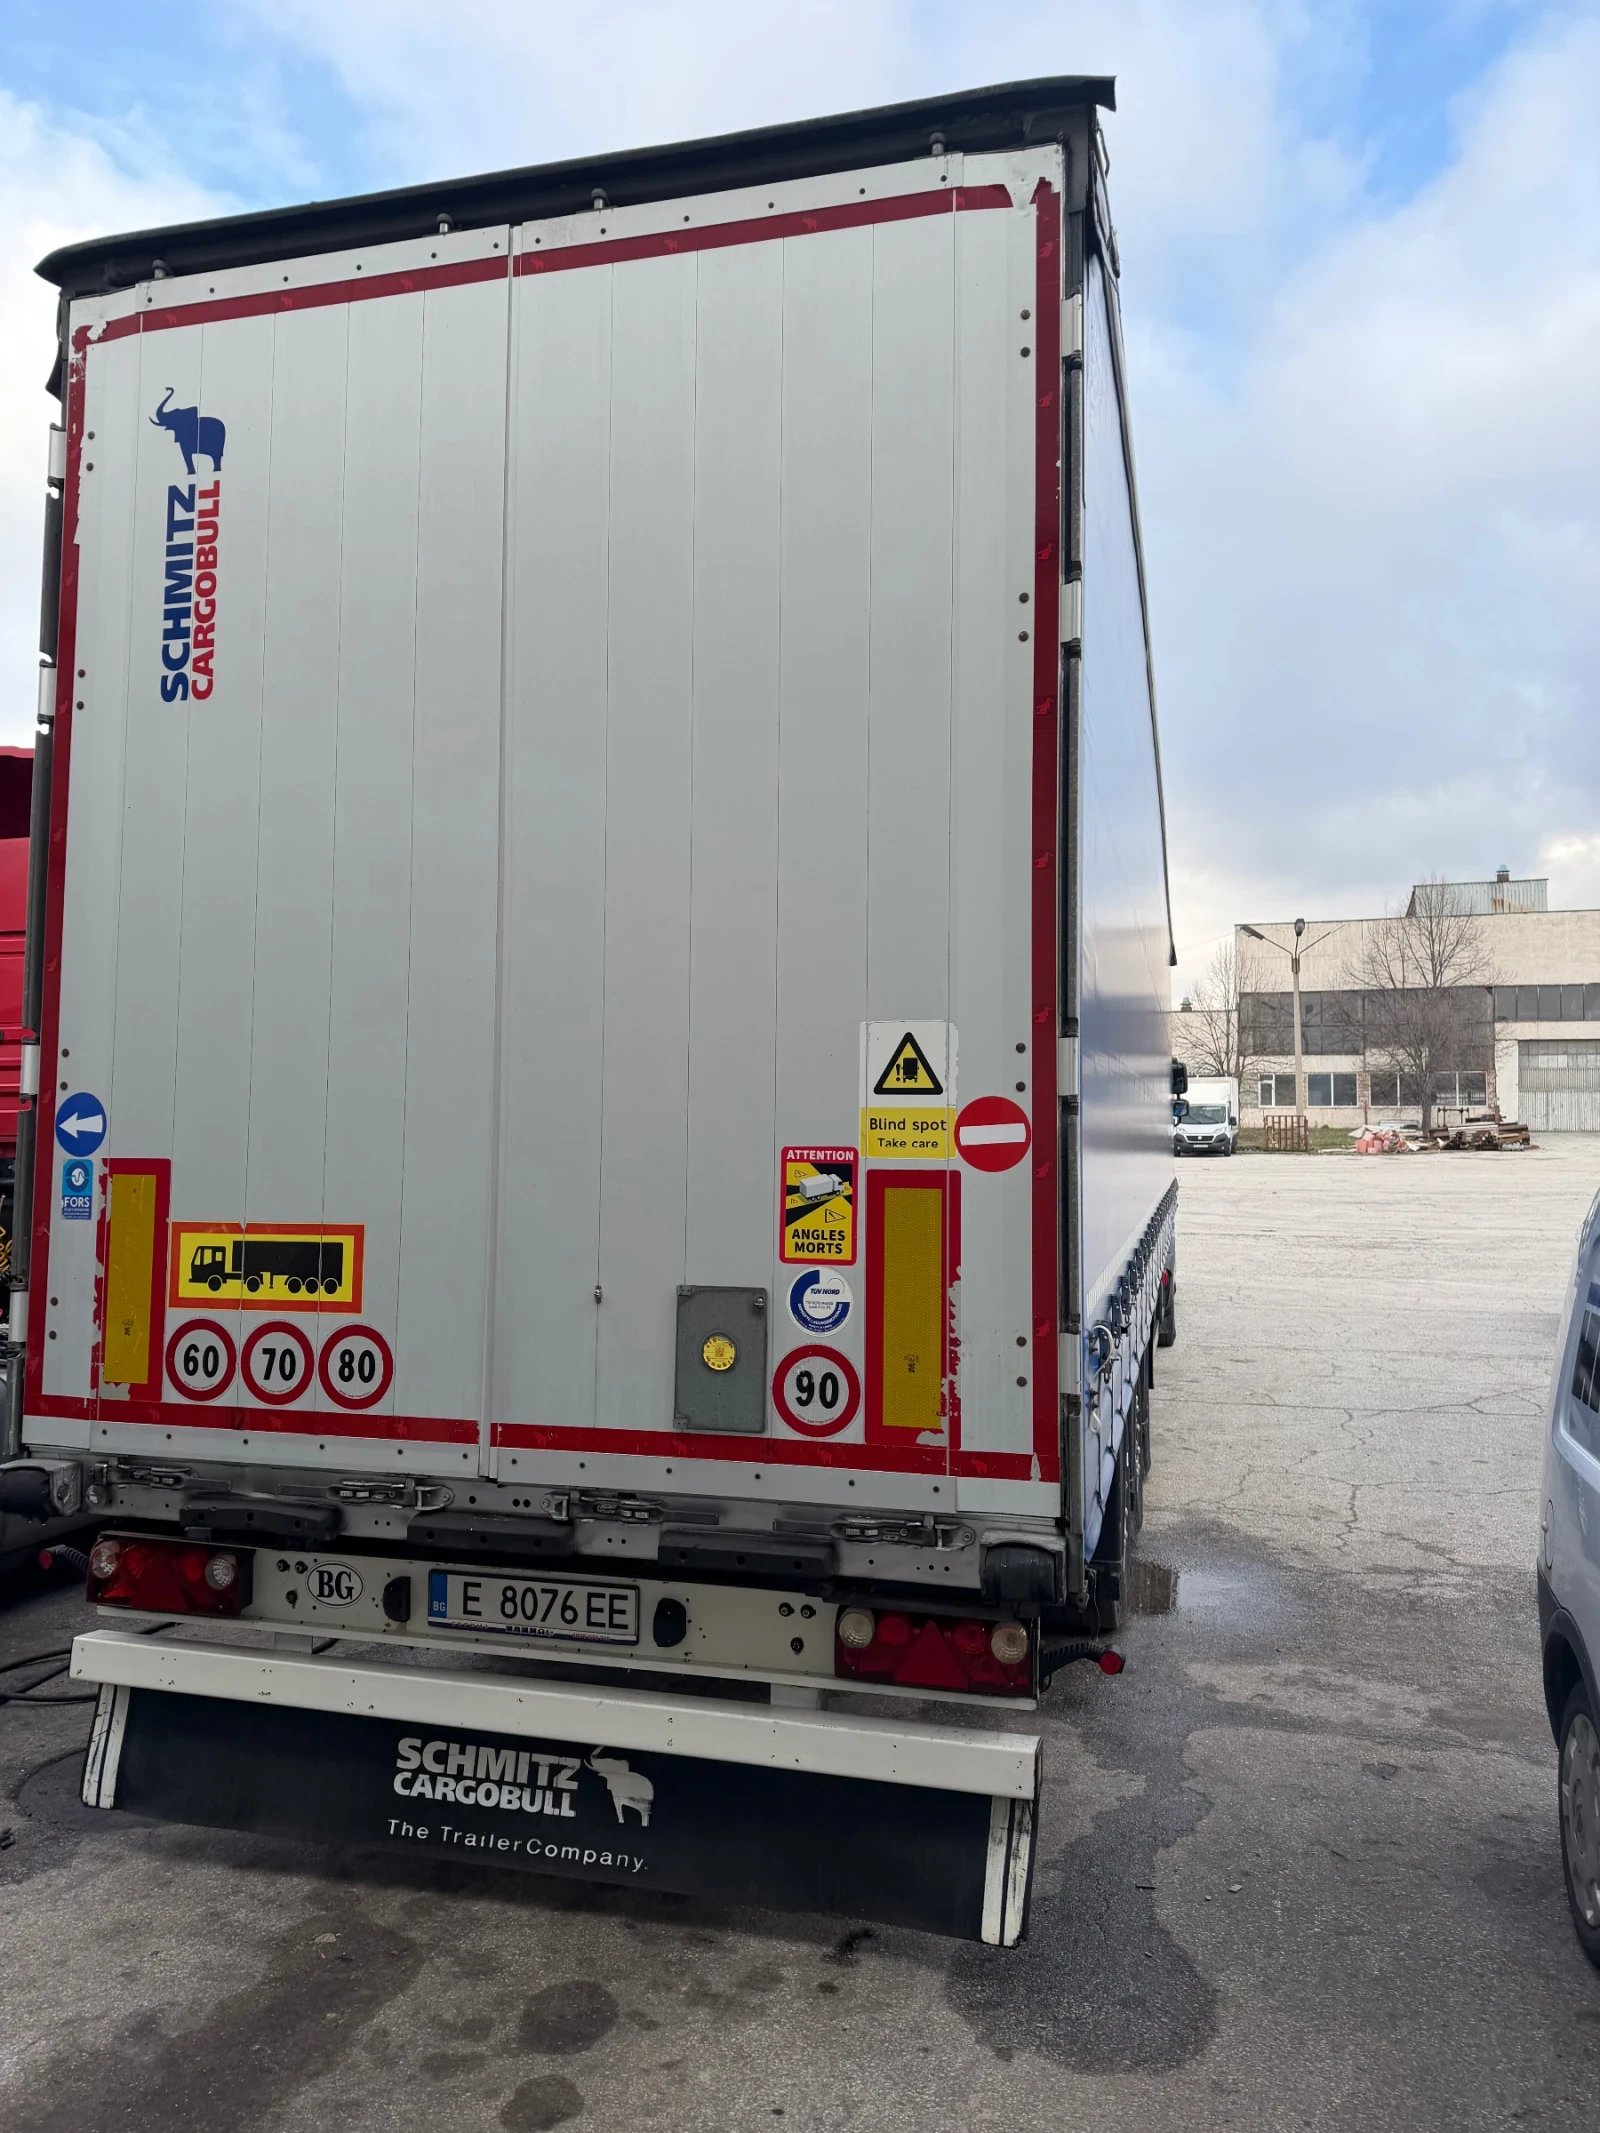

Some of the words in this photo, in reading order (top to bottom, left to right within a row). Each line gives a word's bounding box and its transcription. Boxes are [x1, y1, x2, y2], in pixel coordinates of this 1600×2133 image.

[160, 483, 196, 702] SCHMITZ
[190, 479, 221, 700] CARGOBULL
[869, 1117, 906, 1131] Blind
[912, 1119, 947, 1134] spot
[786, 1149, 854, 1161] ATTENTION
[877, 1137, 907, 1148] Take
[911, 1140, 939, 1148] care
[64, 1196, 90, 1208] FORS
[792, 1228, 846, 1241] ANGLES
[794, 1241, 843, 1254] MORTS
[183, 1343, 220, 1378] 60
[261, 1347, 296, 1381] 70
[338, 1348, 376, 1383] 80
[795, 1370, 839, 1410] 90
[316, 1569, 354, 1600] BG
[433, 1601, 446, 1612] BG
[462, 1581, 482, 1617] E
[500, 1585, 579, 1625] 8076
[586, 1591, 629, 1630] EE
[396, 1737, 582, 1791] SCHMITZ
[393, 1771, 577, 1818] CARGOBULL
[388, 1819, 429, 1839] The
